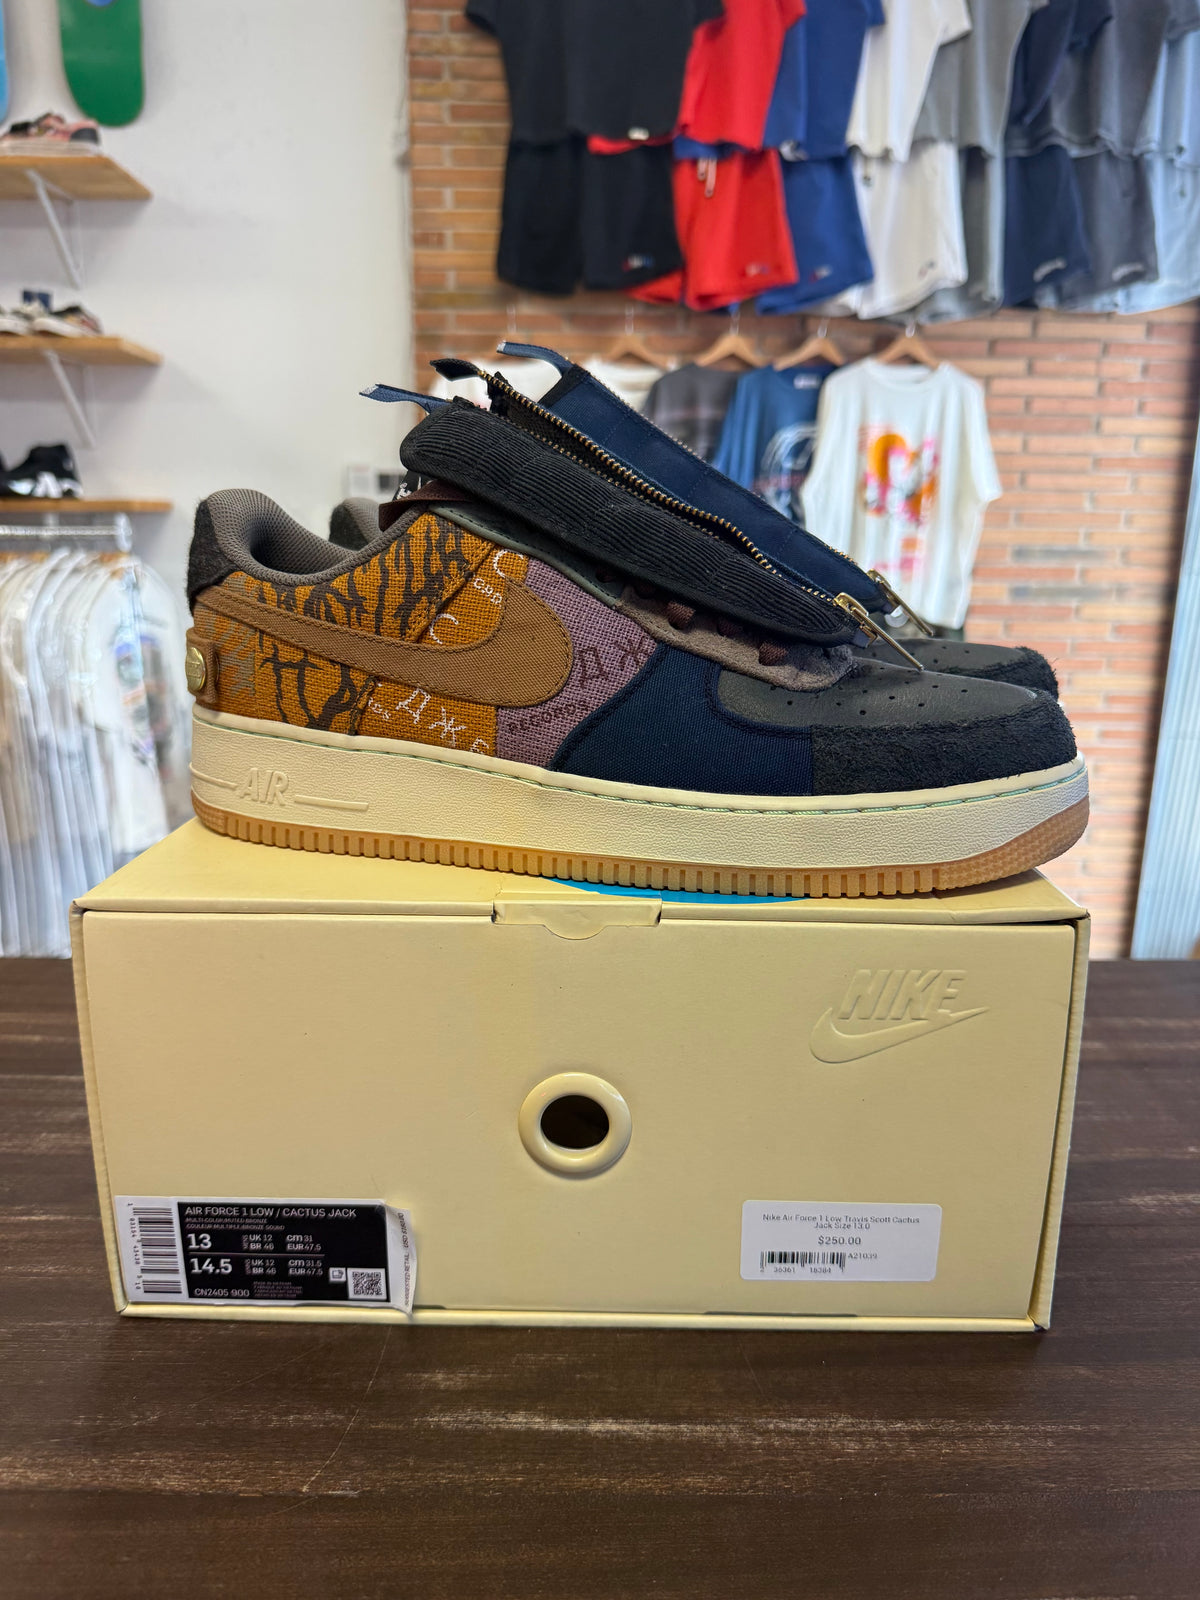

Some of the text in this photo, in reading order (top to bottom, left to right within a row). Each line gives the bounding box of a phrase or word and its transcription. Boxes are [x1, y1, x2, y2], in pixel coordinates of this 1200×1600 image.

[238, 767, 290, 806] AIR
[838, 968, 968, 1021] NIKE
[185, 1206, 203, 1216] AIR
[205, 1206, 240, 1216] FORCE
[242, 1207, 249, 1216] 1
[250, 1207, 275, 1217] LOW
[282, 1207, 326, 1217] CACTUS
[328, 1208, 357, 1218] JACK
[762, 1213, 781, 1221] Nike
[782, 1213, 794, 1221] Air
[845, 1215, 869, 1223] Travis
[870, 1216, 891, 1224] Scott
[892, 1216, 920, 1224] Cactus
[834, 1222, 852, 1230] Size
[854, 1222, 871, 1230] 13.0
[187, 1233, 212, 1250] 13
[249, 1234, 273, 1242] UK 12
[286, 1234, 313, 1243] cm 31
[818, 1234, 862, 1246] $250.00
[249, 1242, 262, 1250] BR
[287, 1243, 322, 1251] EUR 47.5
[190, 1257, 233, 1274] 14.5
[251, 1259, 275, 1267] UK 12
[288, 1259, 322, 1268] cm 31.5
[252, 1267, 277, 1275] BR 46
[289, 1267, 324, 1276] EUR 47.5
[194, 1287, 229, 1297] CN2405
